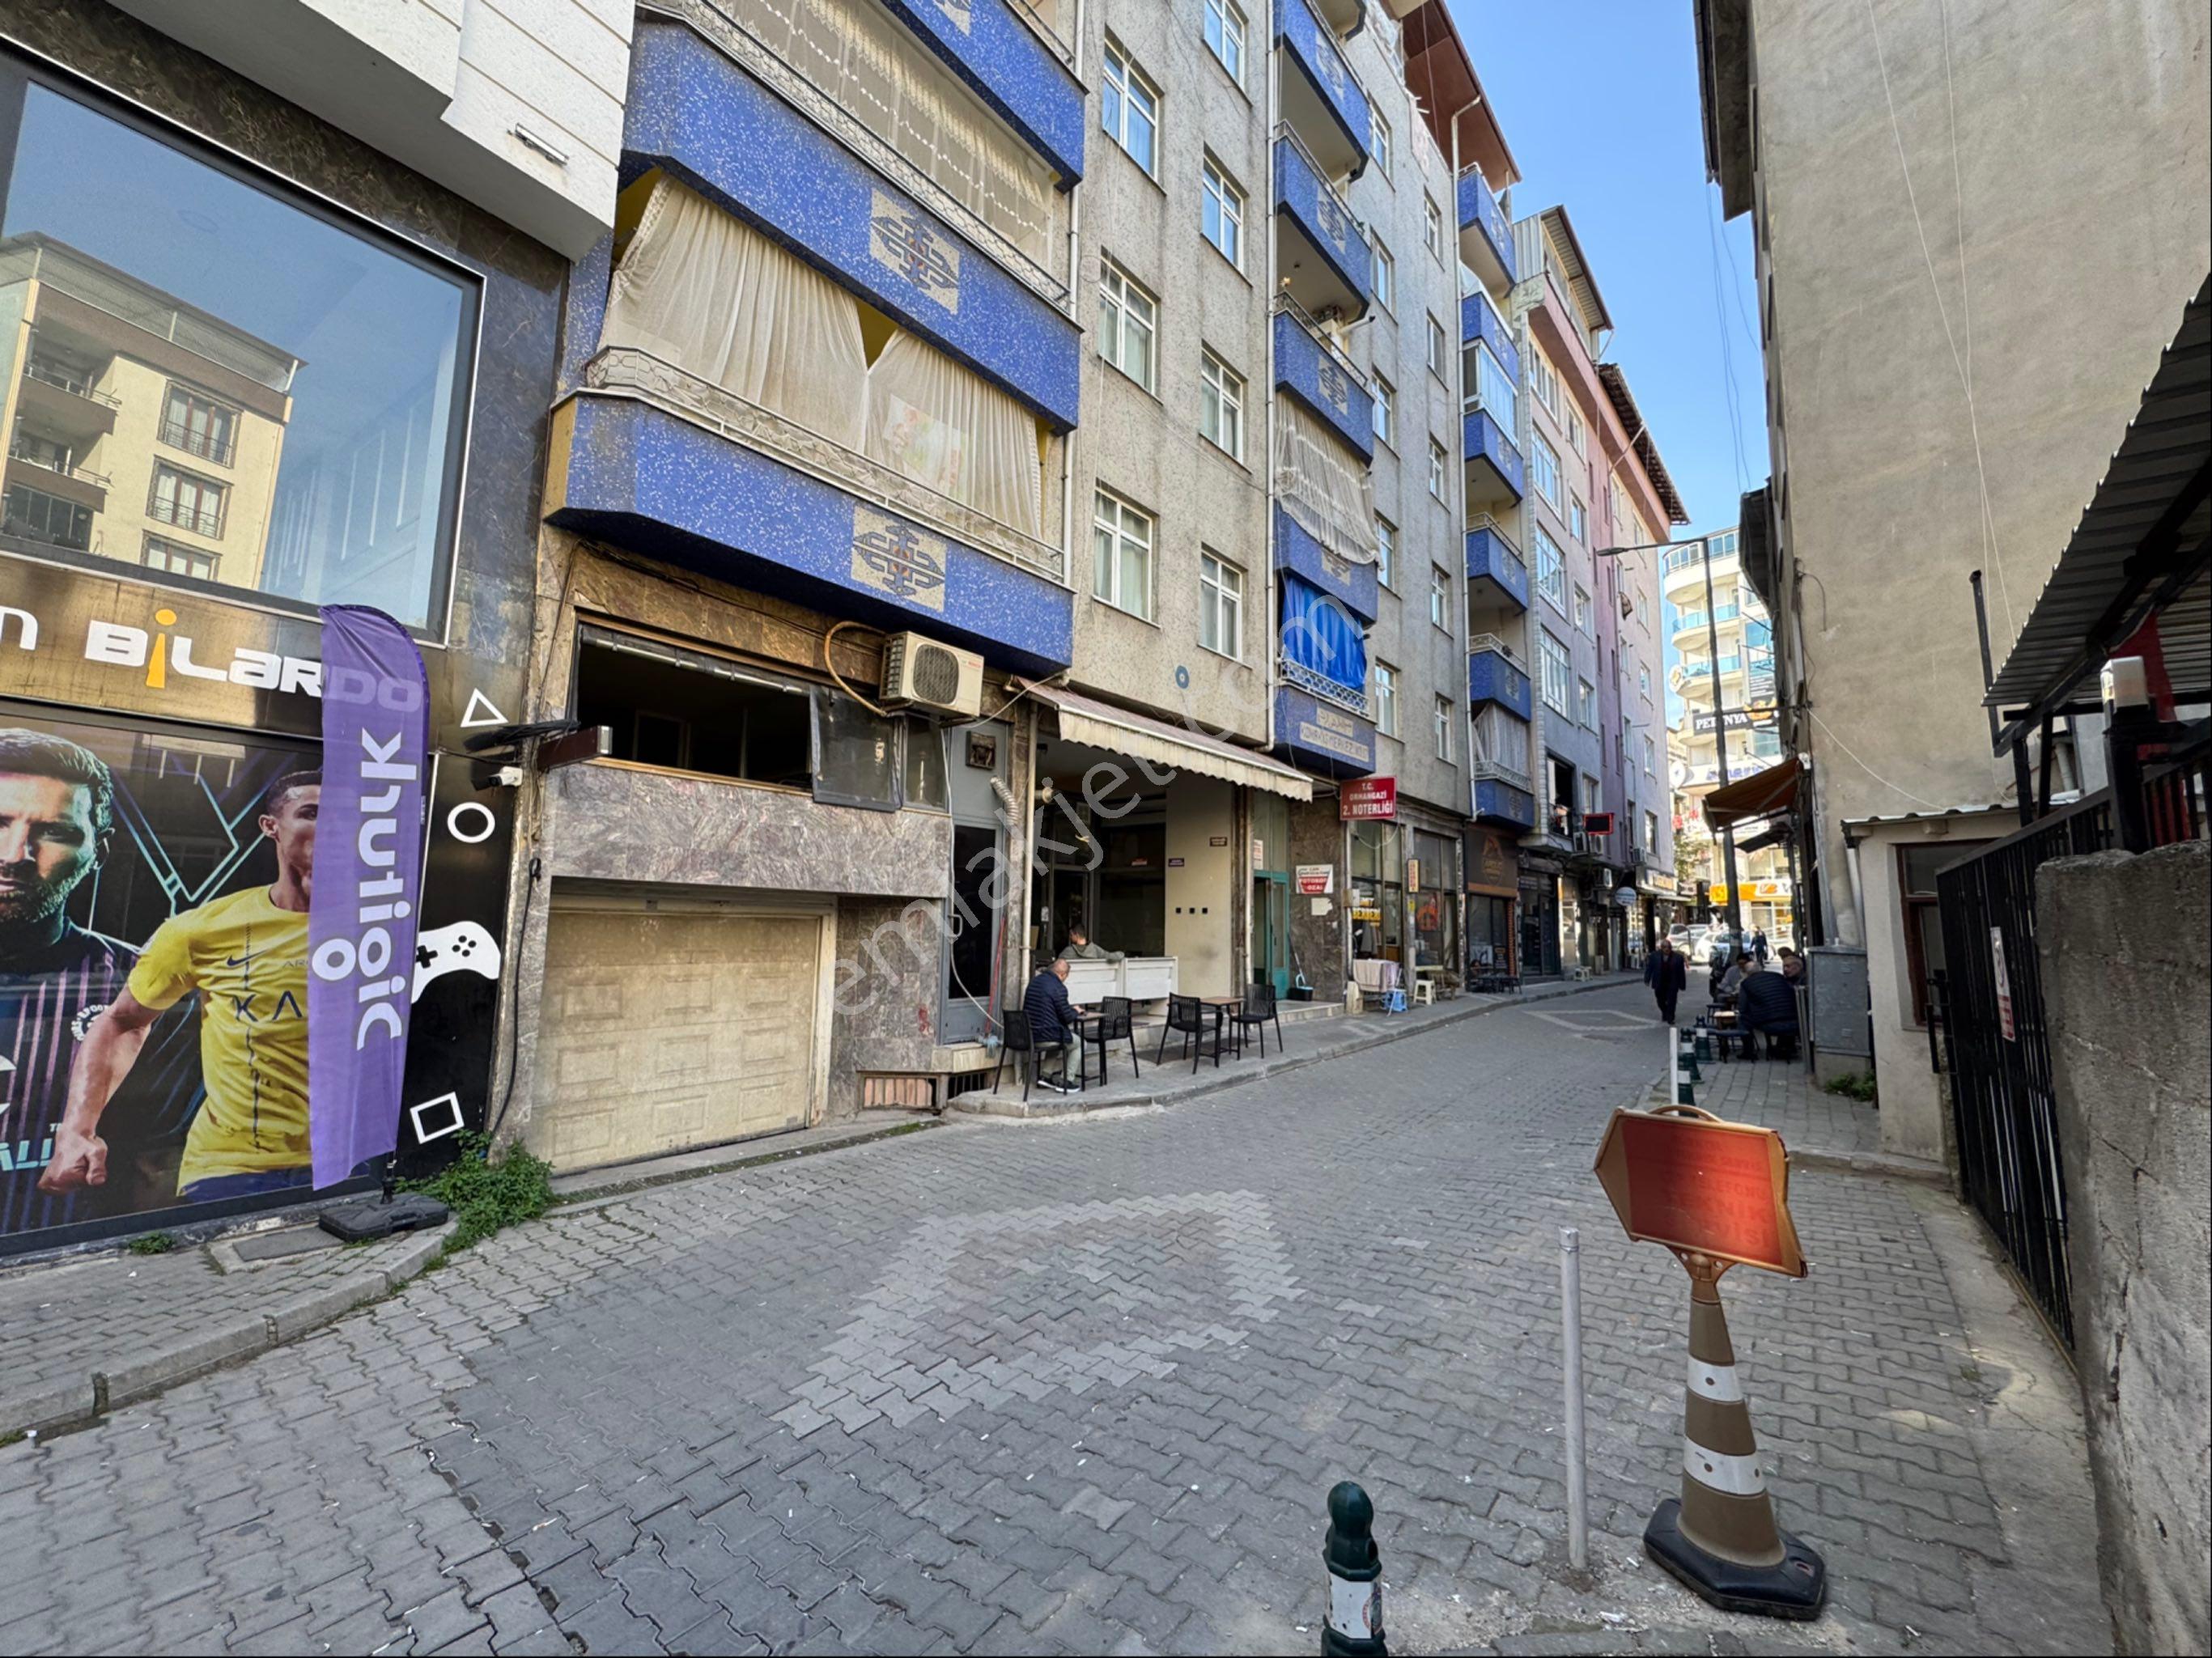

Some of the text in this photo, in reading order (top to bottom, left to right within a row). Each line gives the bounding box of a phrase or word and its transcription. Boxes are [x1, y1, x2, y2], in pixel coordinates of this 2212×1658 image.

[1361, 782, 1373, 791] T.C.
[1349, 791, 1386, 801] ORHANGAZİ
[1343, 799, 1393, 816] 2. NOTERLİĞİ
